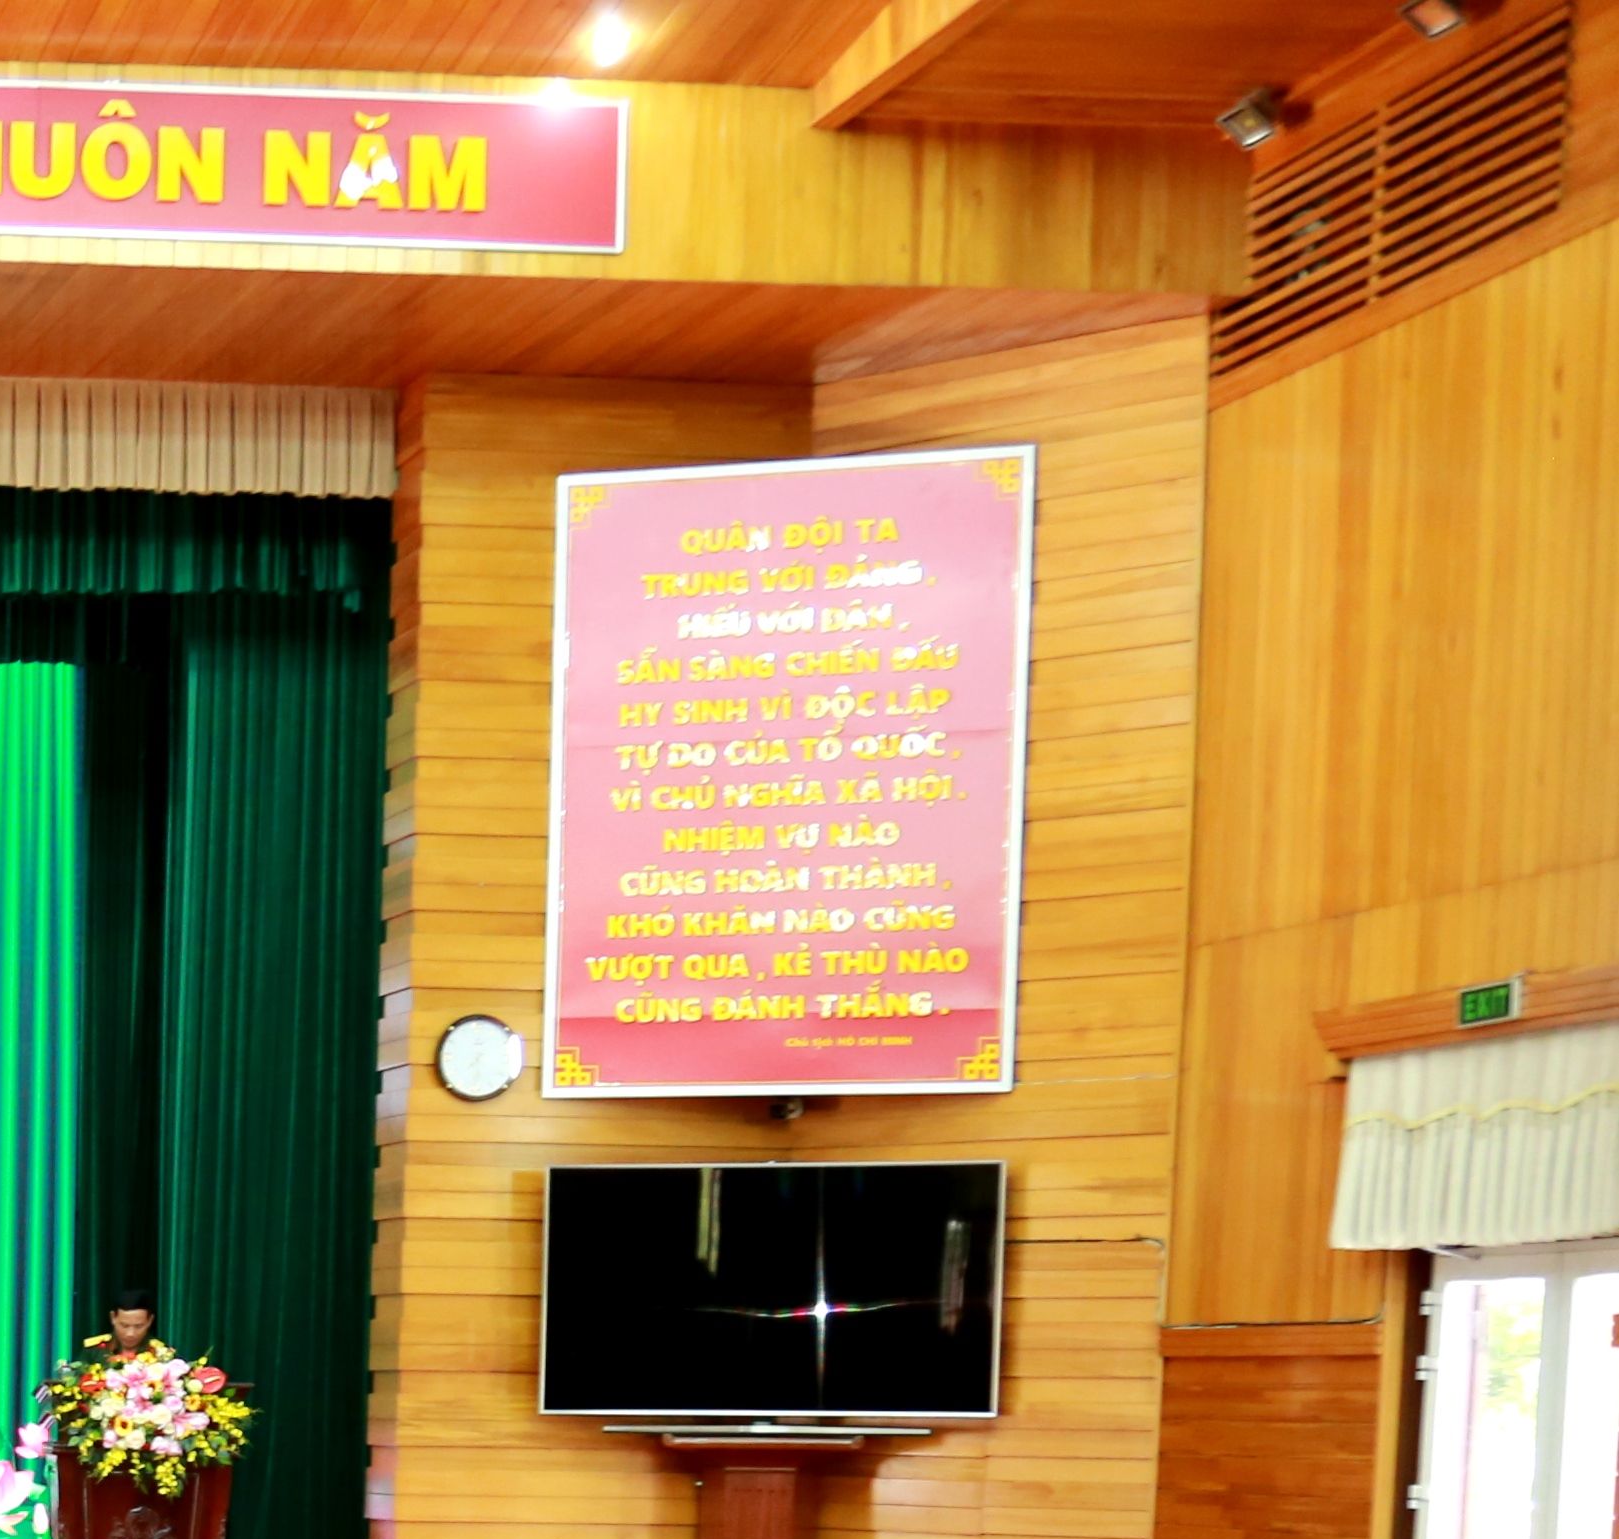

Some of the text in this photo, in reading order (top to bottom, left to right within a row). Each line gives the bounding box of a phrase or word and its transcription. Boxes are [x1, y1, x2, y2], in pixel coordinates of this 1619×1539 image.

[264, 114, 487, 211] NĂM
[782, 515, 844, 554] ĐỘI
[855, 517, 899, 545] TA
[641, 559, 814, 600] TRUNG VỚI
[688, 650, 776, 682] SÀNG
[786, 640, 880, 677] CHIẾN
[618, 702, 663, 728] HY
[673, 698, 749, 726] SINH
[759, 688, 792, 721] VÌ
[886, 683, 950, 719] LẬP
[614, 730, 791, 776] TỰ DO CỦA
[609, 772, 883, 812] VÌ CHỦ NGHĨA XÃ
[663, 814, 900, 856] NHIỆM VỤ NÀO
[607, 900, 956, 939] KHÓ KHĂN NÀO CŨNG
[585, 941, 969, 987] VƯỢT KẺ THÙ NÀO
[615, 989, 805, 1024] CŨNG ĐÁNH
